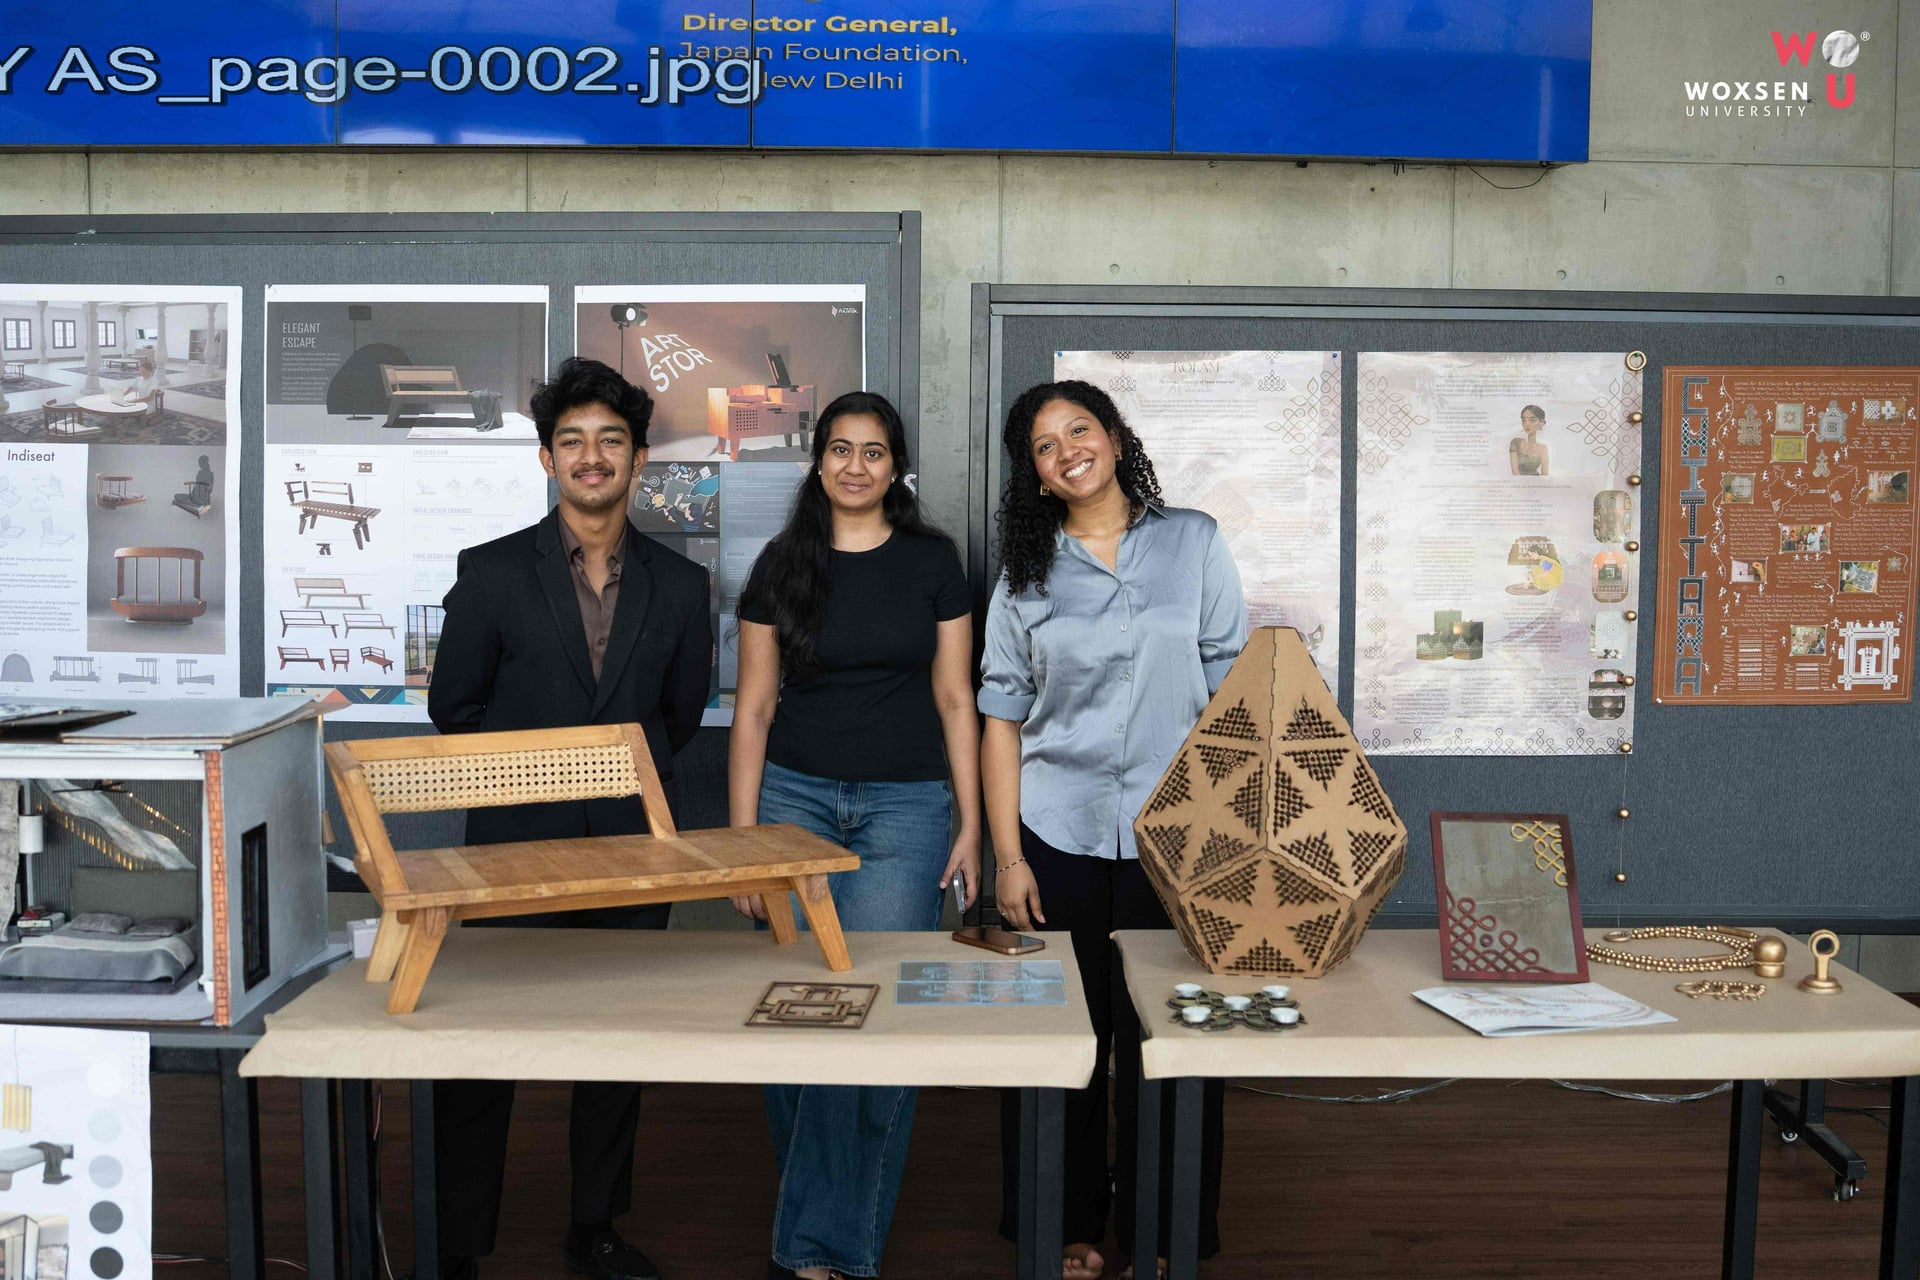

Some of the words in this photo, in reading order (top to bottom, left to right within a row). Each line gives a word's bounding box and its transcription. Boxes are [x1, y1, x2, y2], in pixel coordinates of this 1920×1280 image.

[682, 13, 816, 32] Director
[825, 16, 957, 36] General,
[678, 42, 773, 62] Japan
[785, 43, 968, 65] Foundation,
[47, 46, 760, 104] AS_page-0002.jpg
[761, 72, 815, 89] ew
[825, 71, 904, 89] Delhi
[282, 322, 320, 334] ELEGANT
[282, 337, 316, 348] ESCAPE
[640, 334, 691, 369] ART
[650, 348, 713, 392] STOR
[8, 449, 55, 462] Indiseat
